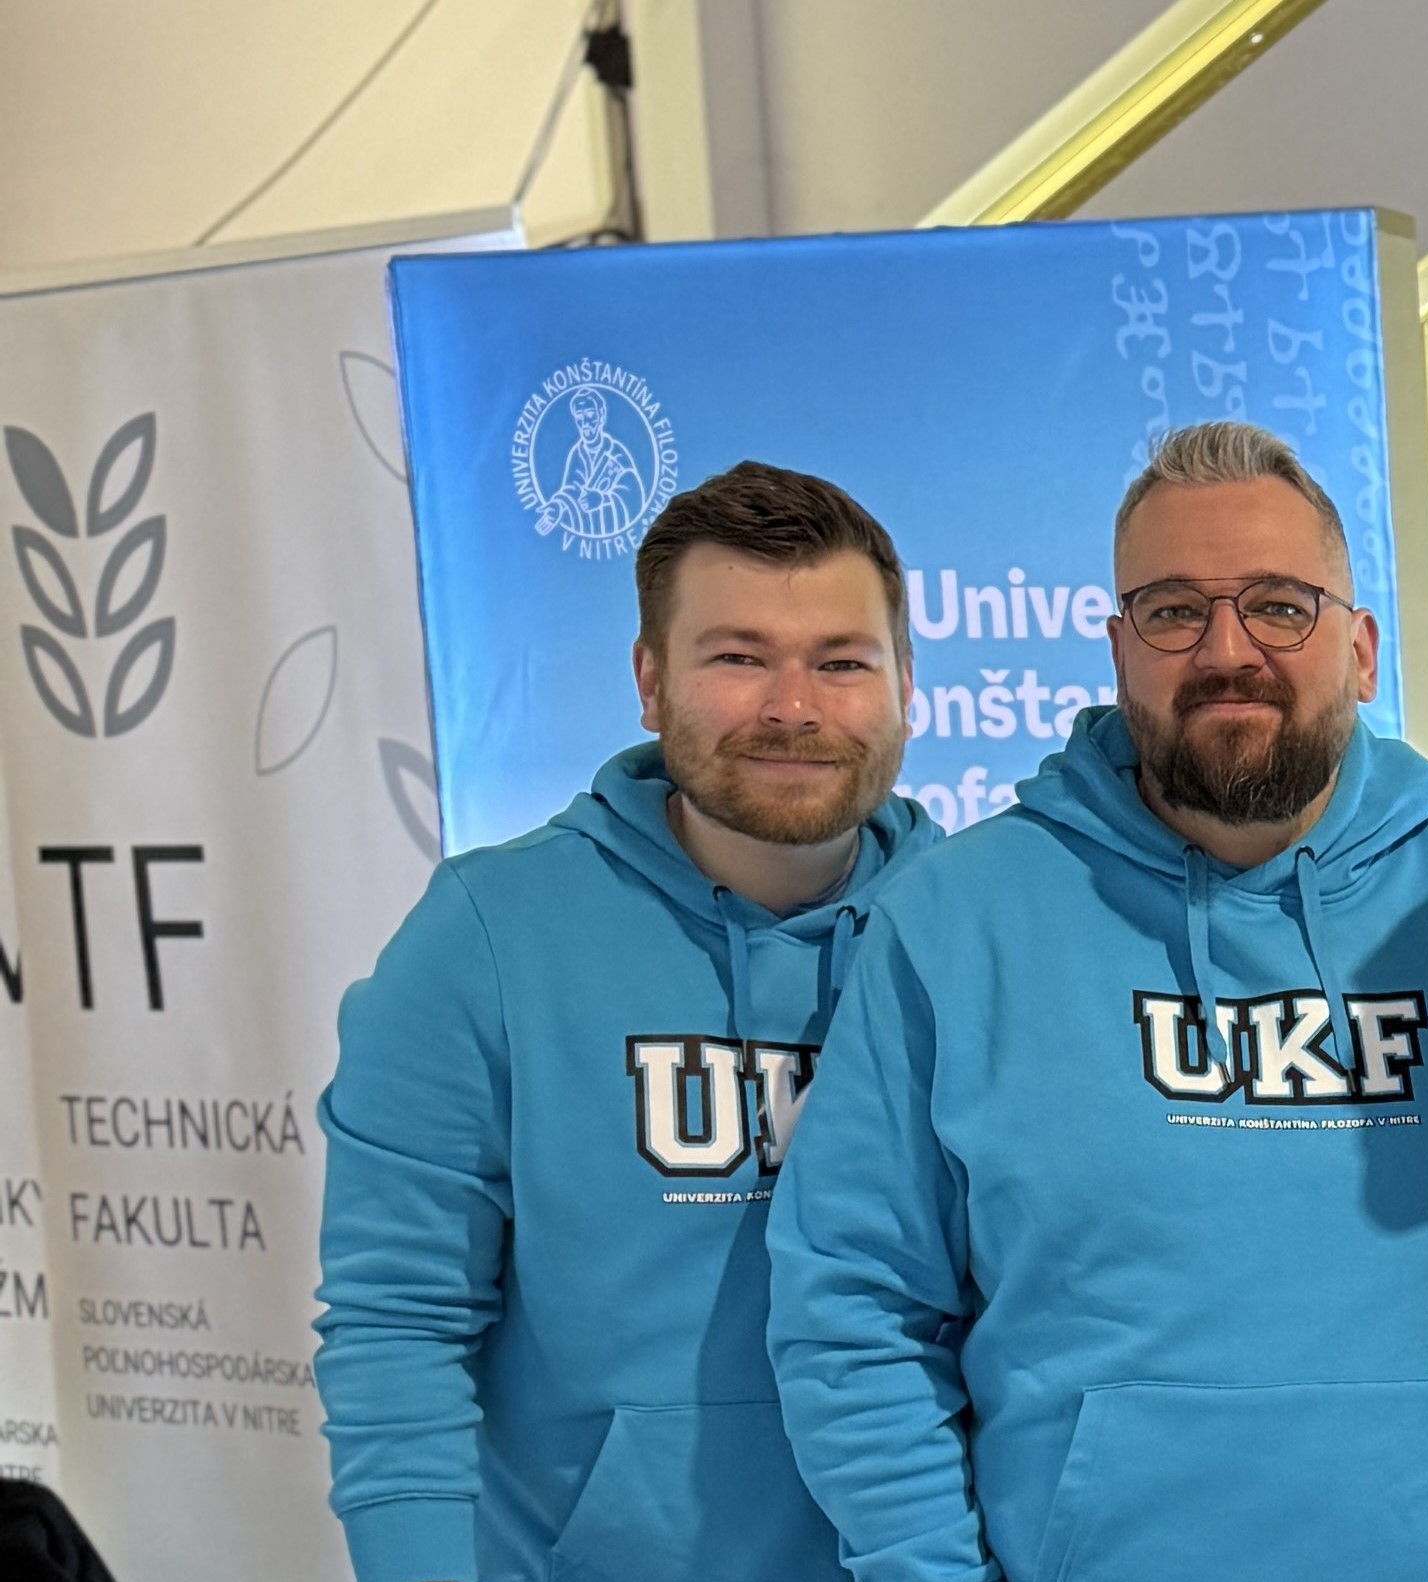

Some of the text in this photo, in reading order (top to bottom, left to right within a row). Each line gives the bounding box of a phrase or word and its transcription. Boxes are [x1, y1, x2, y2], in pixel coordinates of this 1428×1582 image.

[511, 393, 547, 510] UNIVERZITA
[542, 357, 661, 418] KONŠTANTÍNA
[562, 532, 575, 551] V
[38, 845, 205, 1012] TF
[60, 1090, 304, 1155] TECHNICKÁ
[662, 1192, 742, 1203] UNIVERZITA
[69, 1193, 266, 1251] FAKULTA
[79, 1298, 211, 1331] SLOVENSKÁ
[83, 1346, 316, 1389] POĽNOHOSPODÁRSKA
[87, 1395, 302, 1437] UNIVERZITA V NITRE
